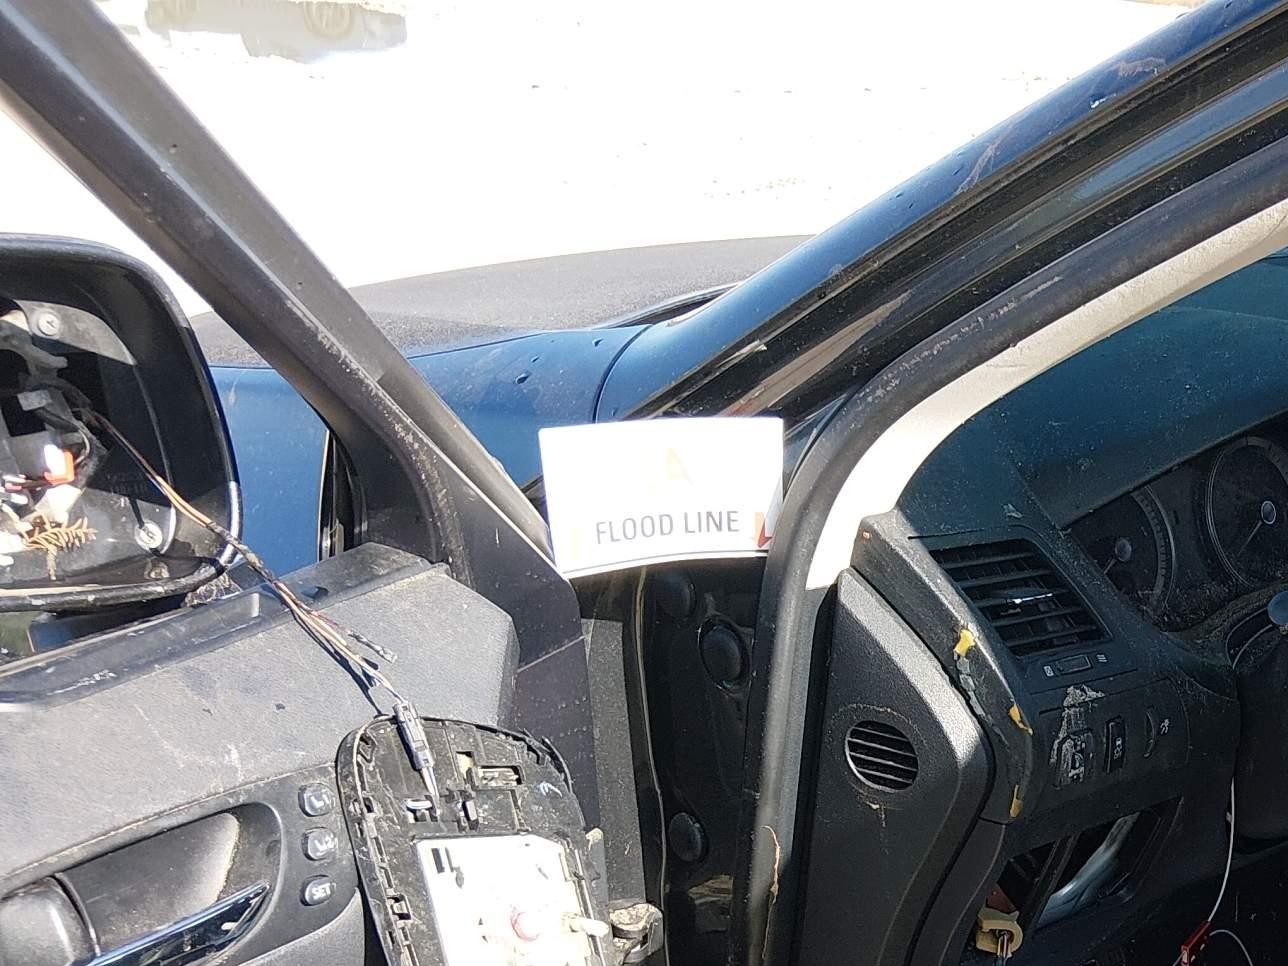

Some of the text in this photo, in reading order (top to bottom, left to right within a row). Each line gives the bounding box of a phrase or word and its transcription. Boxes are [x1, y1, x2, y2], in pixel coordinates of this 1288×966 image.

[596, 510, 741, 544] FLOOD LINE
[311, 881, 332, 901] SET
